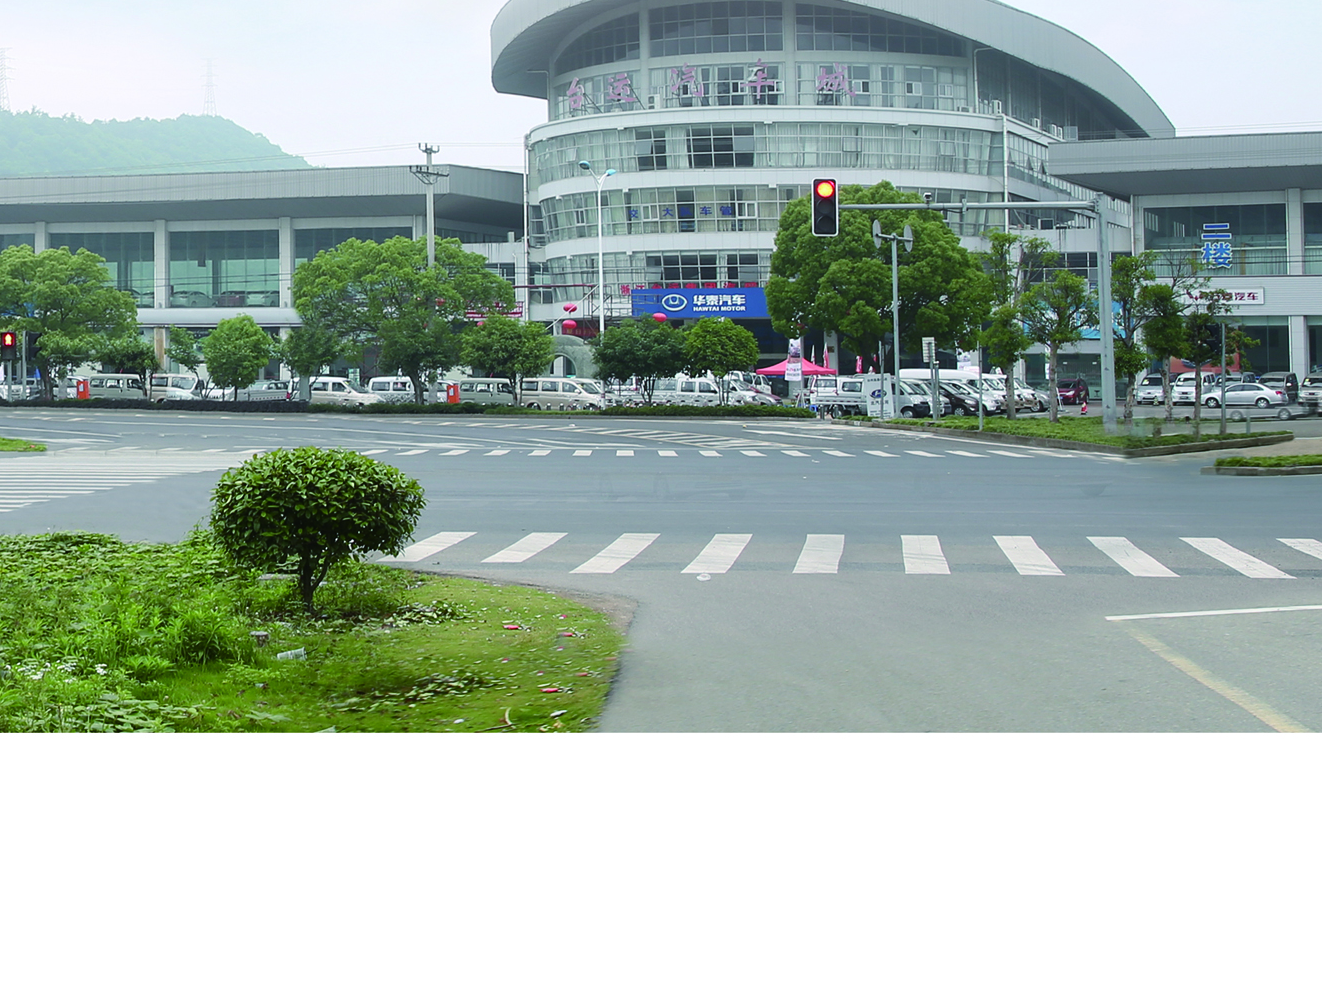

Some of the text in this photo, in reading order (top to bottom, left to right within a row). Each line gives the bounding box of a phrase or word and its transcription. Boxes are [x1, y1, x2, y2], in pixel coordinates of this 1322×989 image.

[566, 58, 856, 109] 台运汽车城
[693, 294, 746, 306] 华泰汽车
